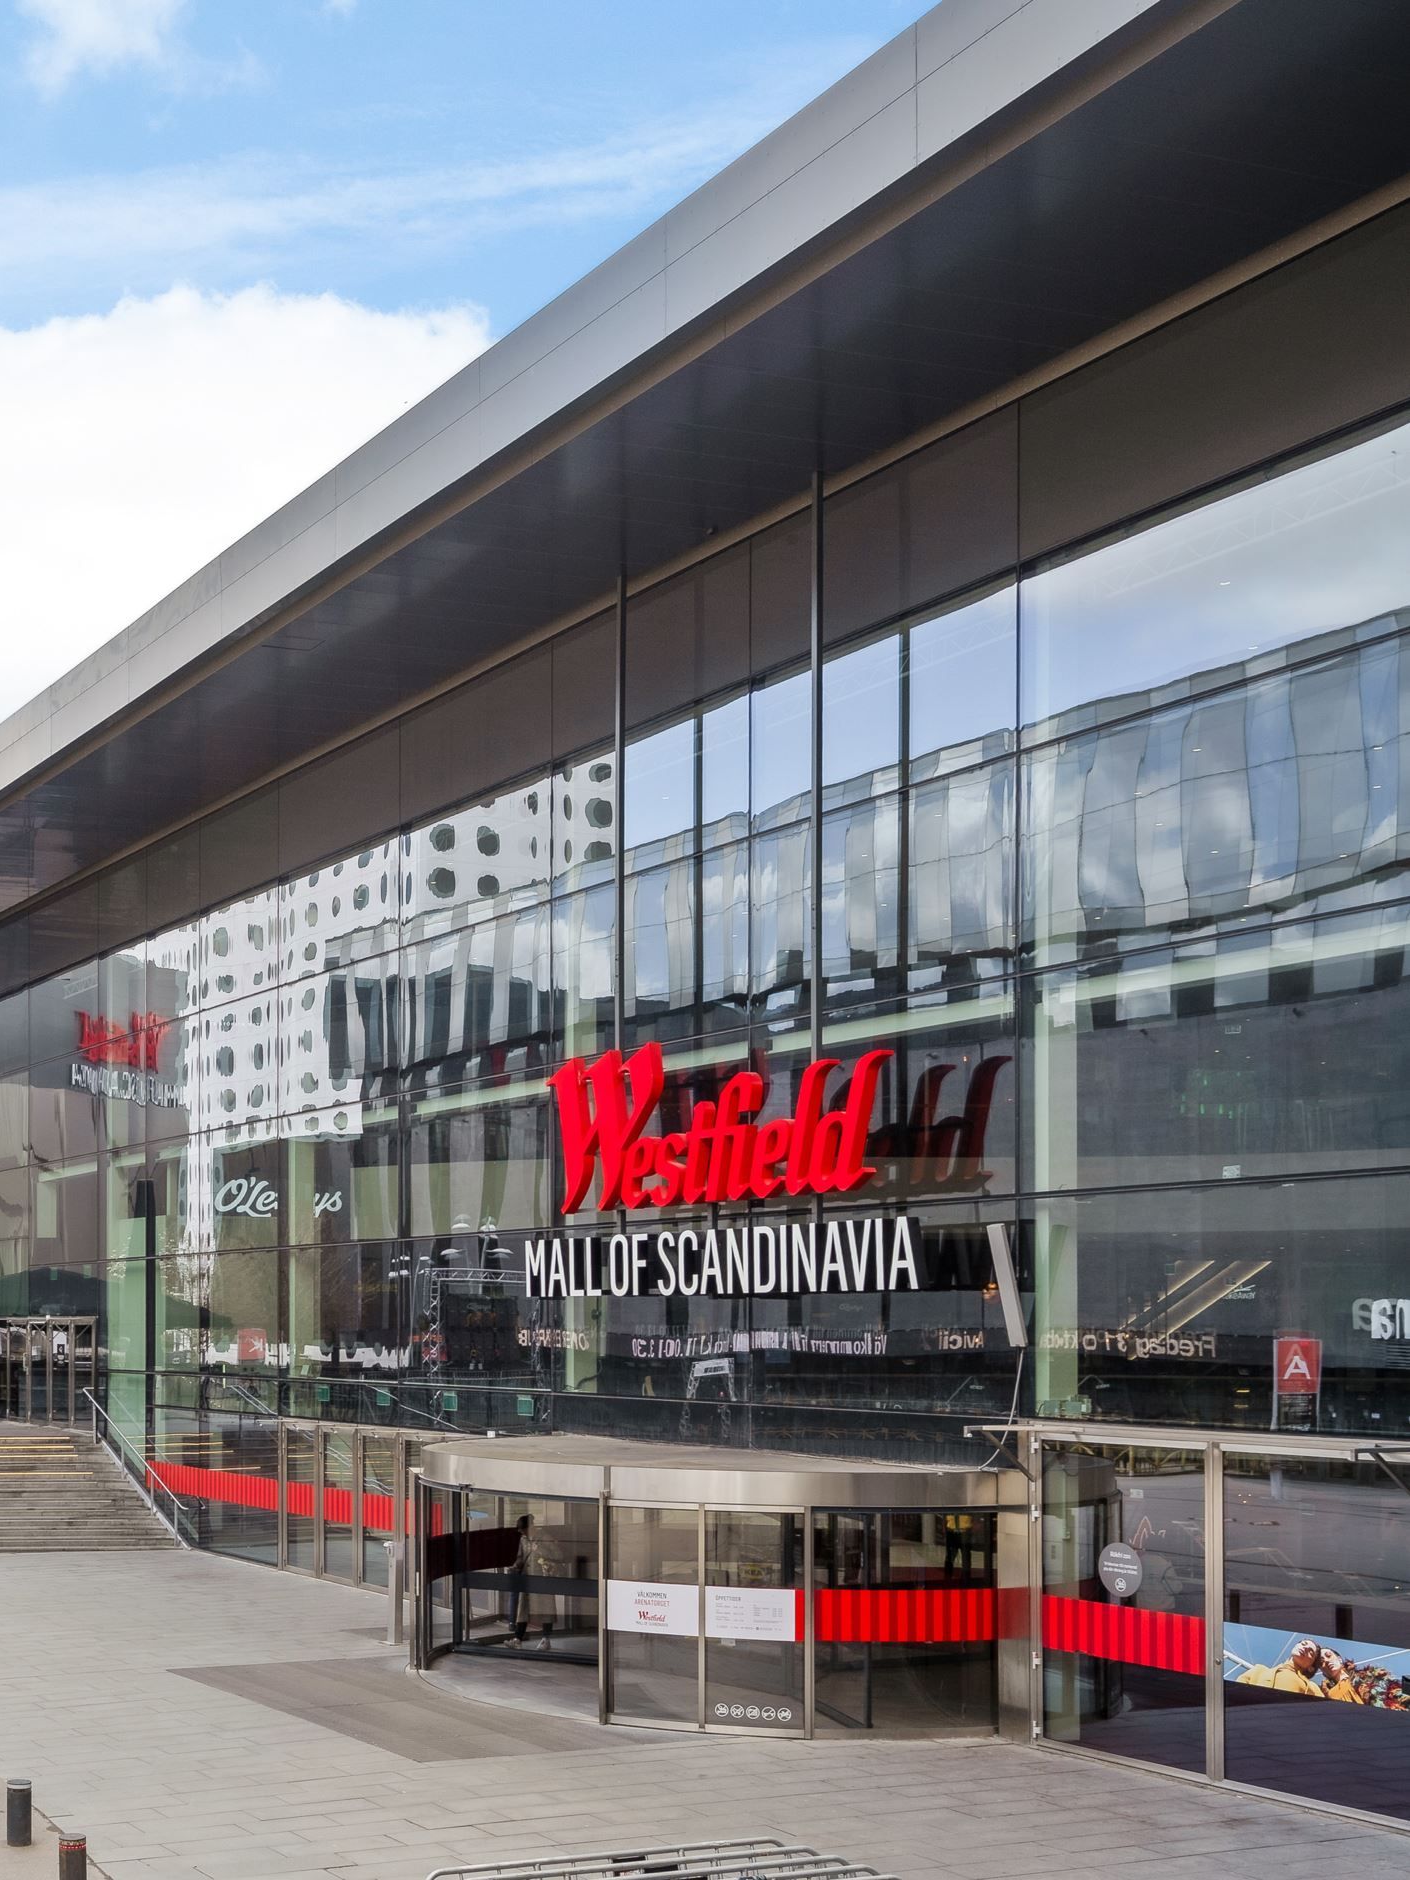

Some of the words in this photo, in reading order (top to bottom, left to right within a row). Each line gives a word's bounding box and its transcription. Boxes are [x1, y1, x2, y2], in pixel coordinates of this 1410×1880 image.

[546, 1041, 894, 1214] Westfield
[214, 1176, 343, 1218] O'Leys
[525, 1237, 602, 1298] MALL
[609, 1233, 648, 1297] OF
[657, 1216, 919, 1296] SCANDINAVIA
[637, 1590, 667, 1599] VÄLKOMMEN
[638, 1610, 666, 1622] Westfield
